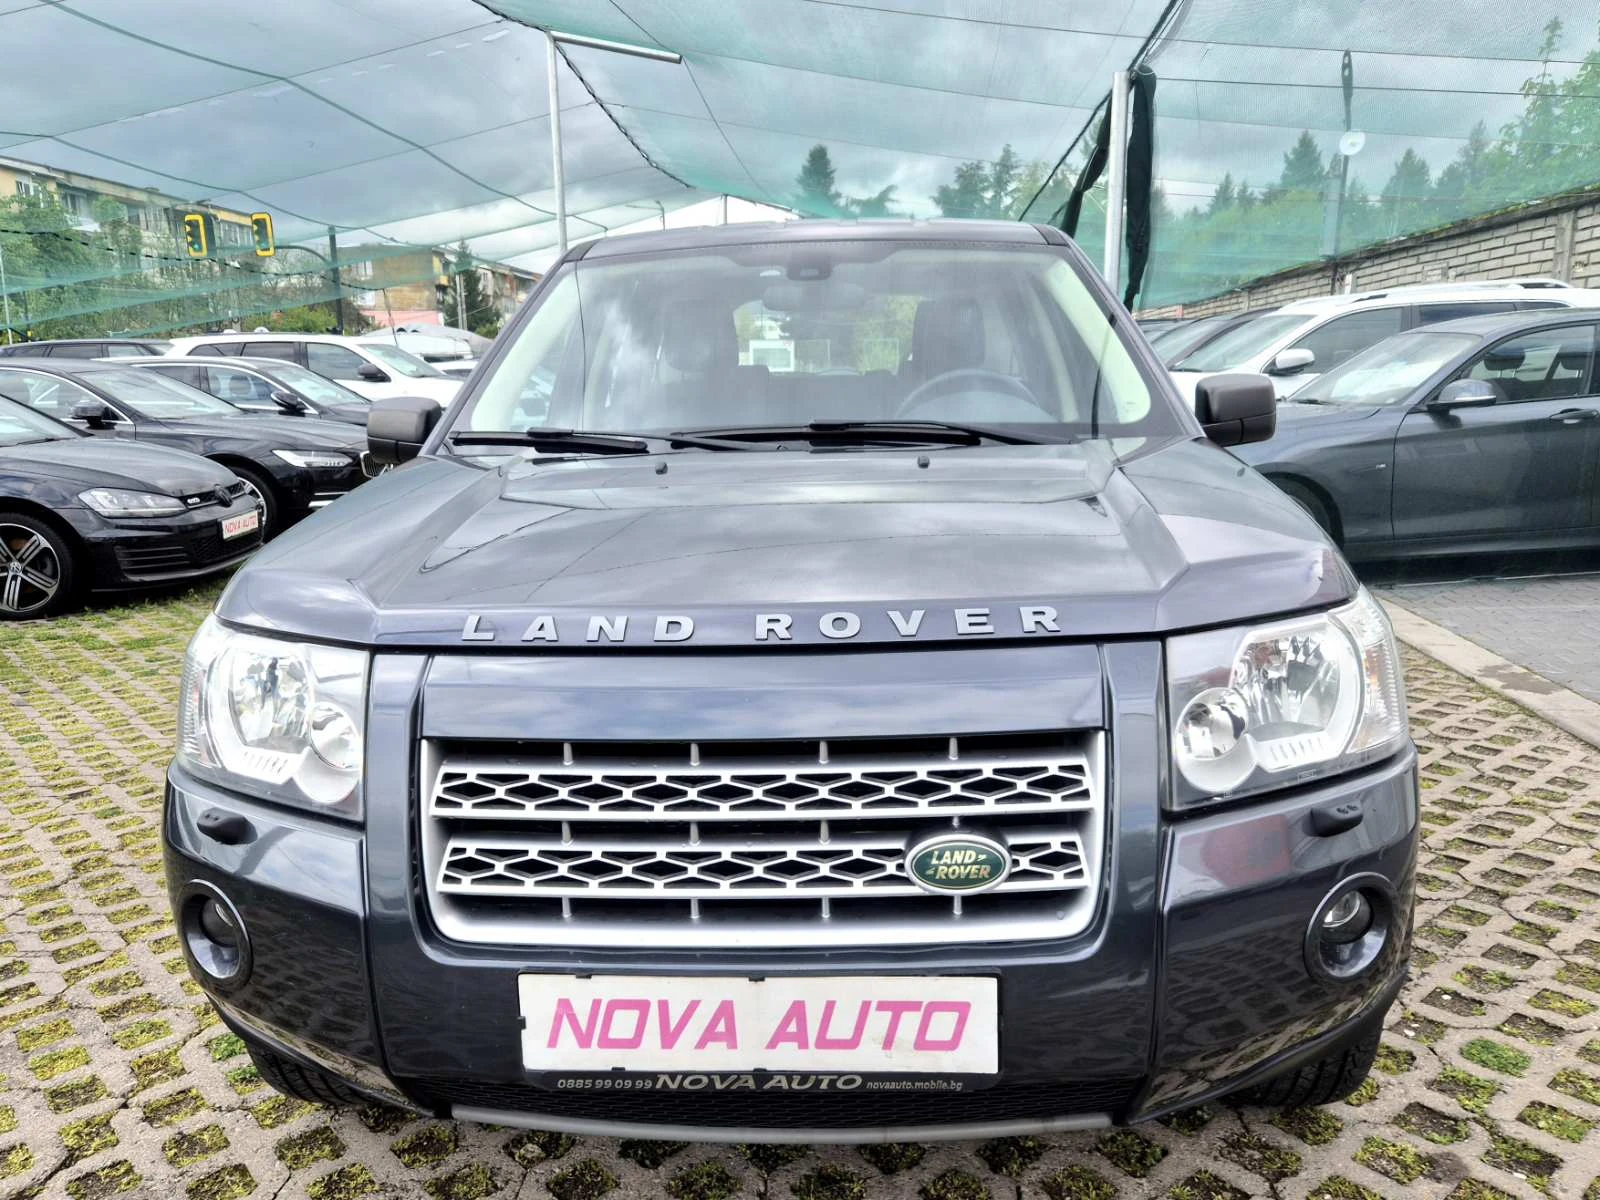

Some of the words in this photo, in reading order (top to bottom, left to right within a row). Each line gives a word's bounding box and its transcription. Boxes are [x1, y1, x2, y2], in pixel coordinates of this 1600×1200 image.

[461, 614, 695, 642] LAND
[754, 606, 1061, 641] ROVER
[931, 849, 977, 865] LAND
[935, 864, 991, 880] ROVER
[546, 998, 738, 1050] NOVA
[765, 1000, 972, 1051] AUTO
[557, 1078, 593, 1089] 0885
[594, 1078, 612, 1089] 99
[614, 1078, 632, 1089] 09
[634, 1078, 652, 1089] 99
[655, 1073, 756, 1090] NOVA
[763, 1074, 863, 1090] AUTO
[866, 1079, 963, 1091] novaauto.mobile.bg
